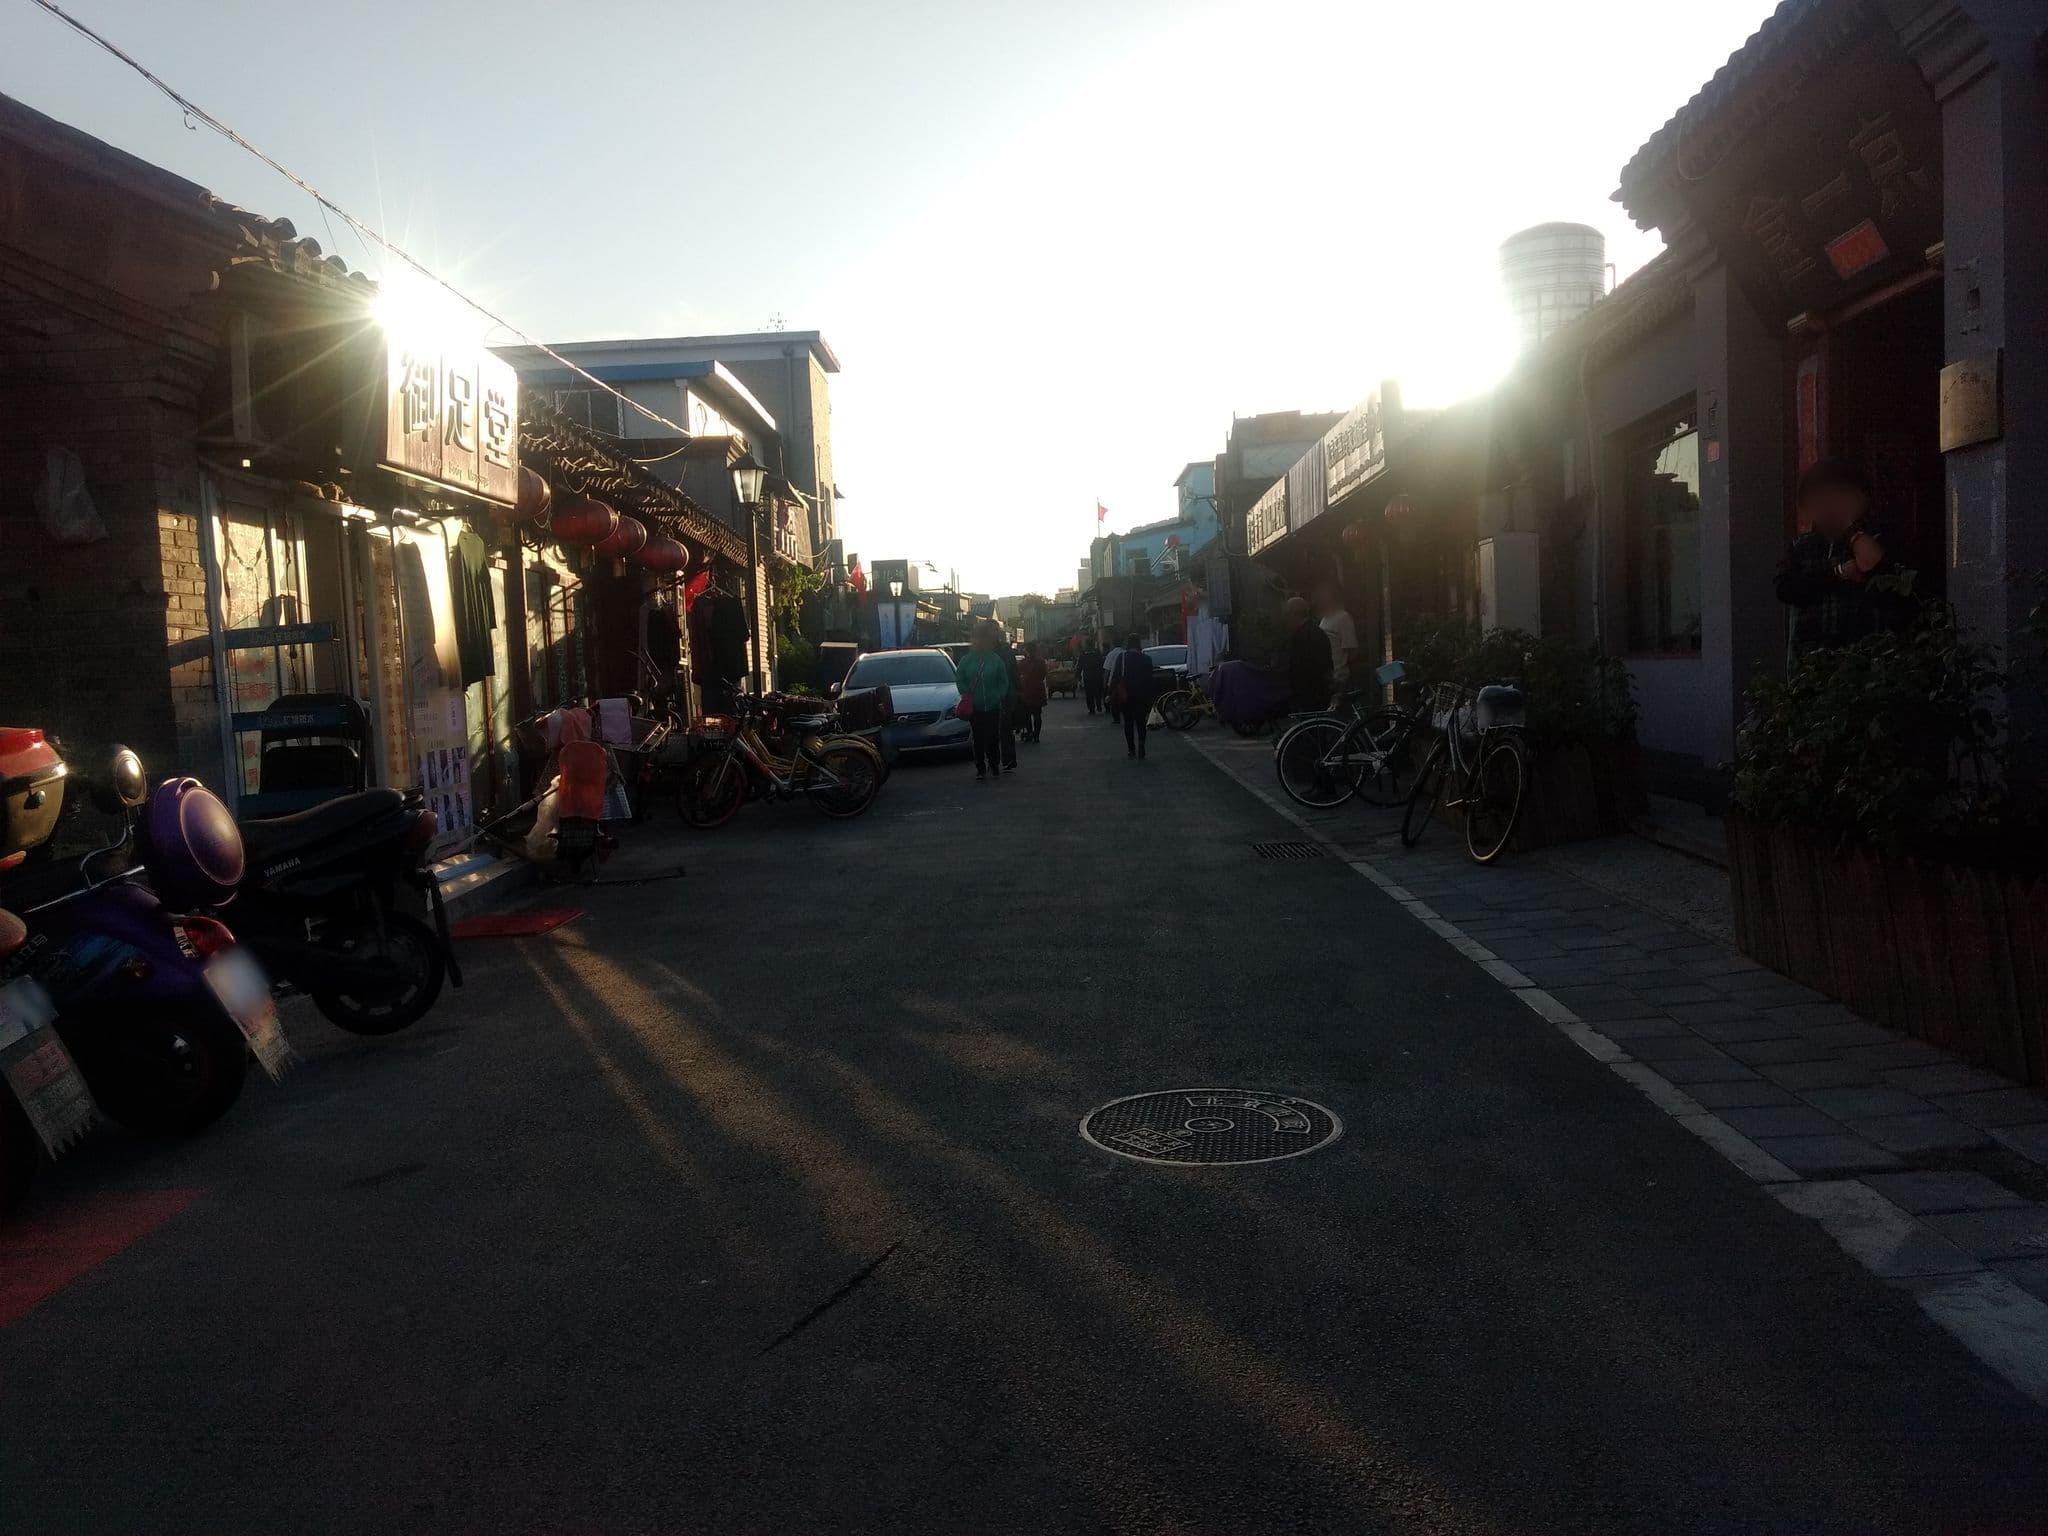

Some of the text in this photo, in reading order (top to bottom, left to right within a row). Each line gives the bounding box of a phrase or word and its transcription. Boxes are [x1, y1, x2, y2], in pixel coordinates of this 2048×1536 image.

[398, 352, 512, 470] 御足堂
[263, 856, 302, 878] YAMAHA
